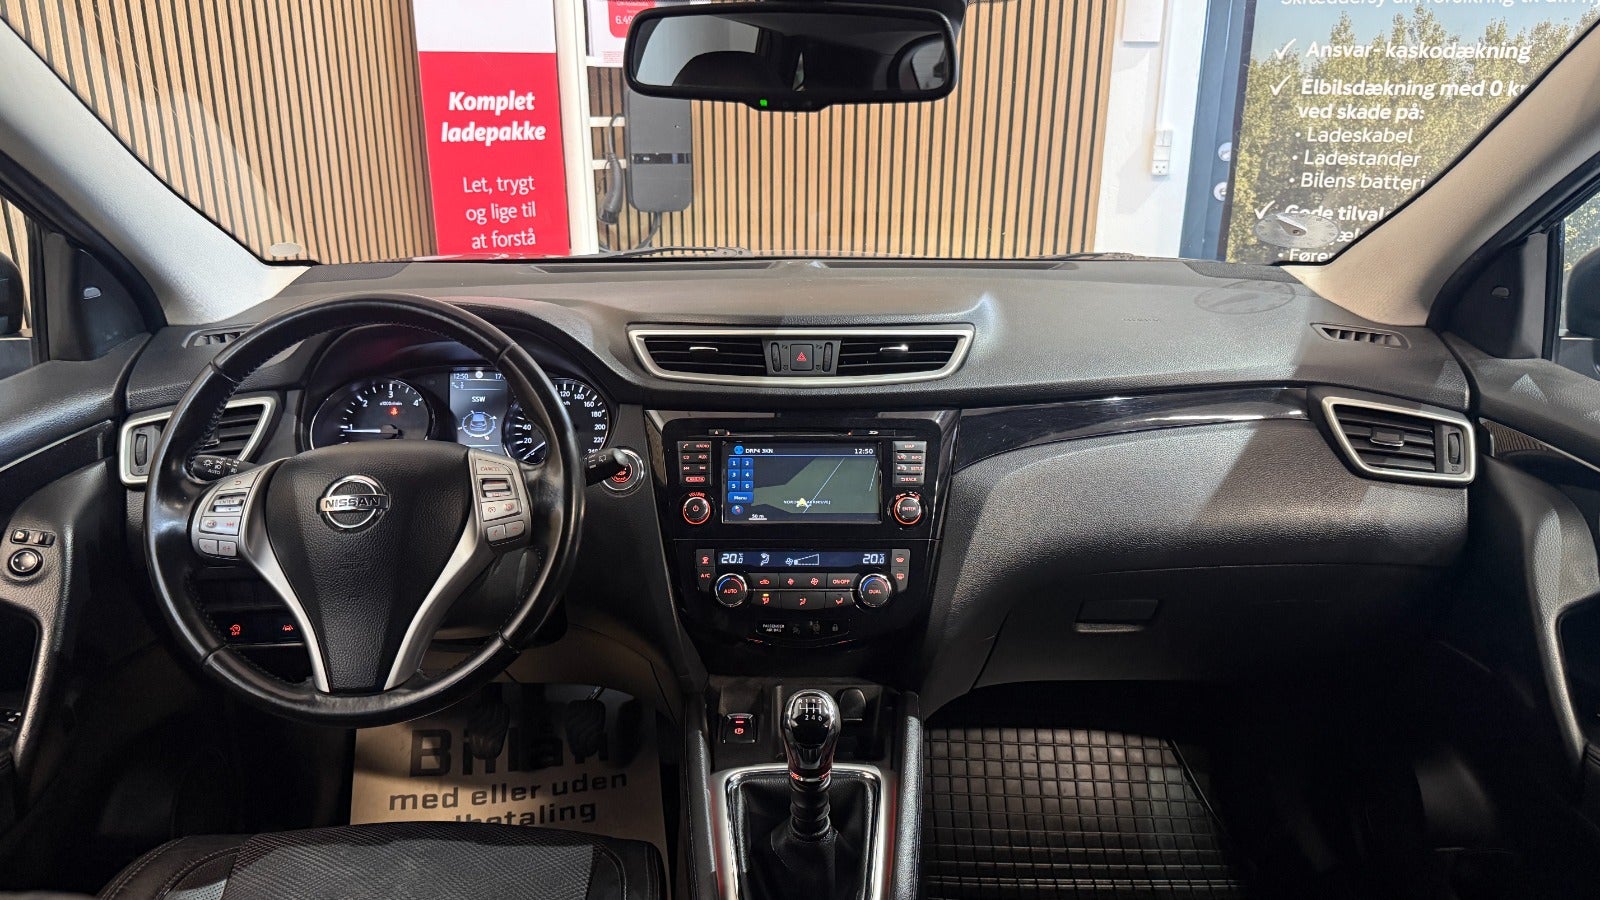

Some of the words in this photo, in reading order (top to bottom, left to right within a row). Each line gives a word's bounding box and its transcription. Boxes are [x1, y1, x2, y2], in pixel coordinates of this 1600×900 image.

[1385, 42, 1533, 64] kaskodækning
[1301, 78, 1437, 100] Elbilsdækning
[1439, 80, 1486, 97] med
[1489, 80, 1503, 97] 0
[448, 89, 535, 116] Komplet
[1299, 104, 1332, 119] ved
[1336, 105, 1391, 120] skade
[1394, 103, 1425, 123] på:
[441, 120, 546, 147] ladepakke
[1307, 126, 1414, 144] Ladeskabel
[1303, 149, 1422, 168] Ladestander
[463, 176, 493, 195] Let,
[496, 175, 536, 196] trygt
[1300, 172, 1356, 188] Bilens
[1360, 173, 1426, 191] batteri
[465, 208, 488, 225] og
[490, 203, 518, 224] lige
[521, 200, 537, 218] til
[1337, 205, 1392, 222] tilval
[471, 233, 489, 250] at
[491, 227, 537, 249] forstå
[362, 399, 369, 408] 2
[388, 391, 394, 399] 3
[413, 399, 420, 407] 4
[325, 496, 381, 509] NISSAN
[721, 553, 744, 564] 20.0
[389, 787, 459, 810] med
[471, 782, 540, 806] eller
[552, 773, 628, 796] uden
